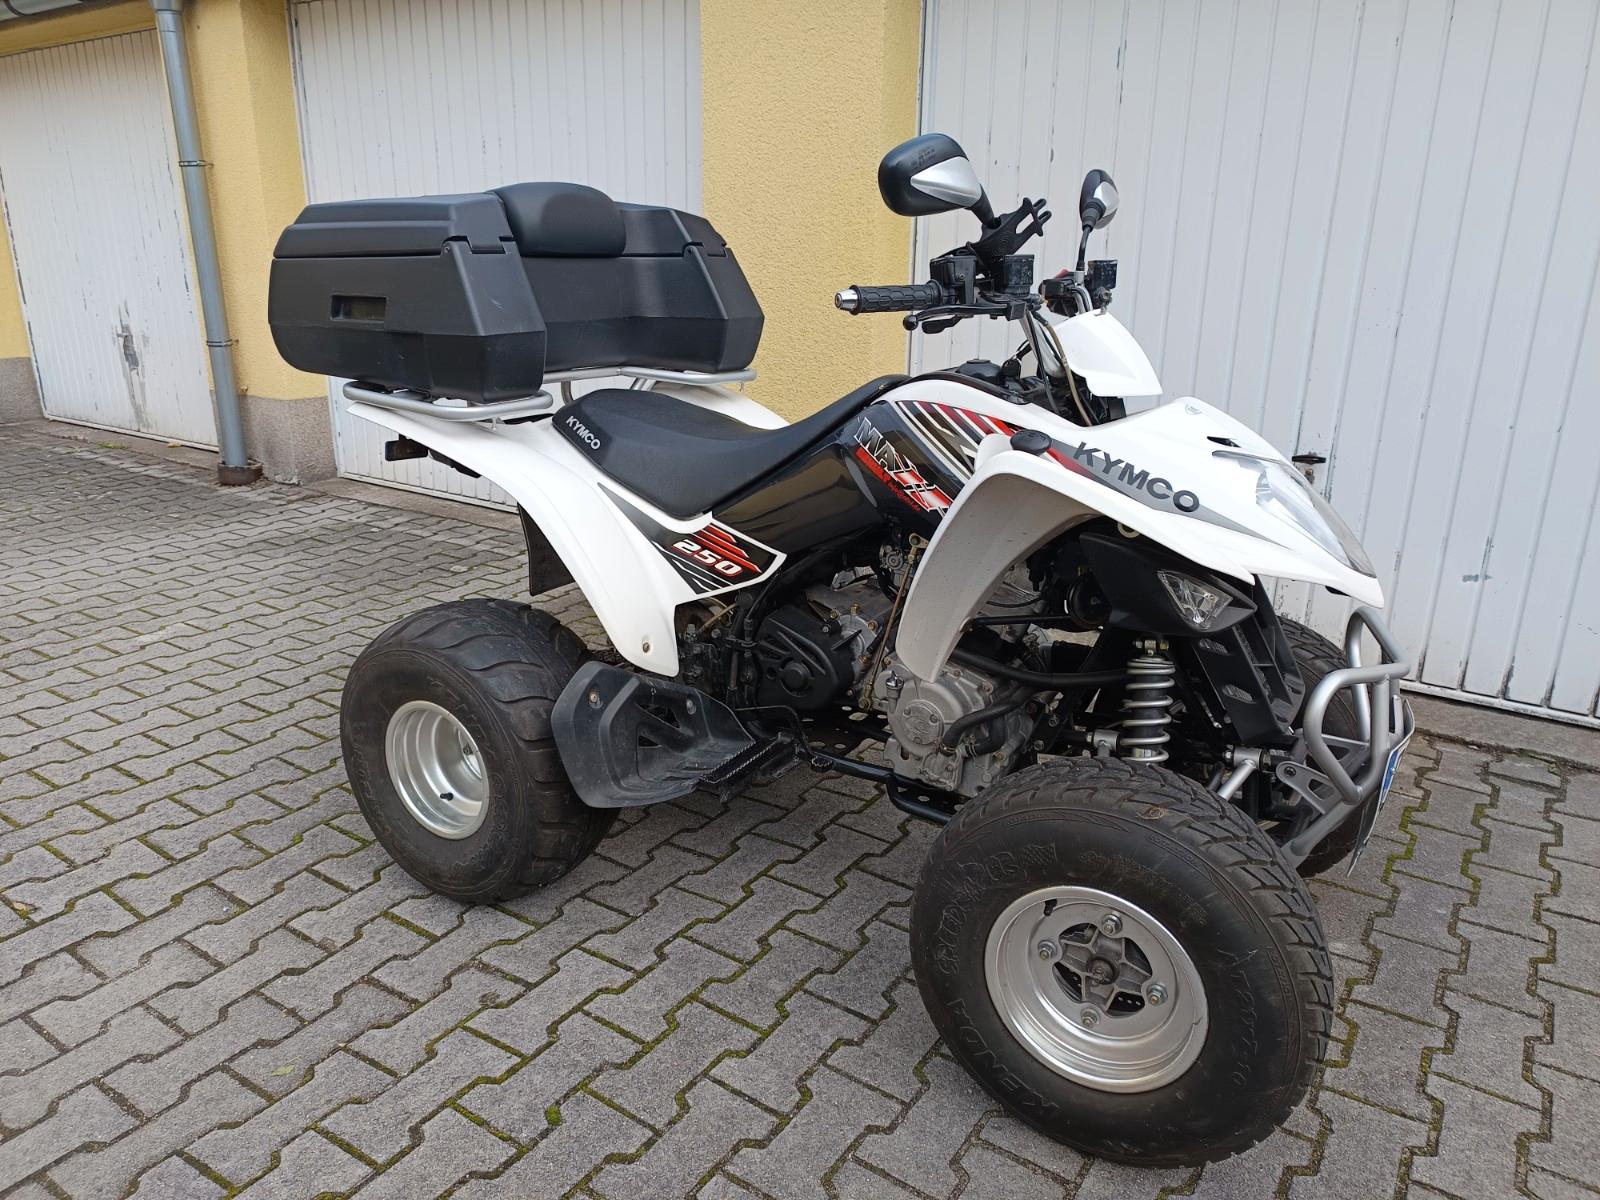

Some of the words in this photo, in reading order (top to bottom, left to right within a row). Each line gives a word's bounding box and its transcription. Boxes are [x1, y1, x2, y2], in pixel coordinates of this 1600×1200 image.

[565, 415, 601, 451] KYMCO
[1072, 441, 1200, 513] KYMCO
[672, 539, 743, 577] 250
